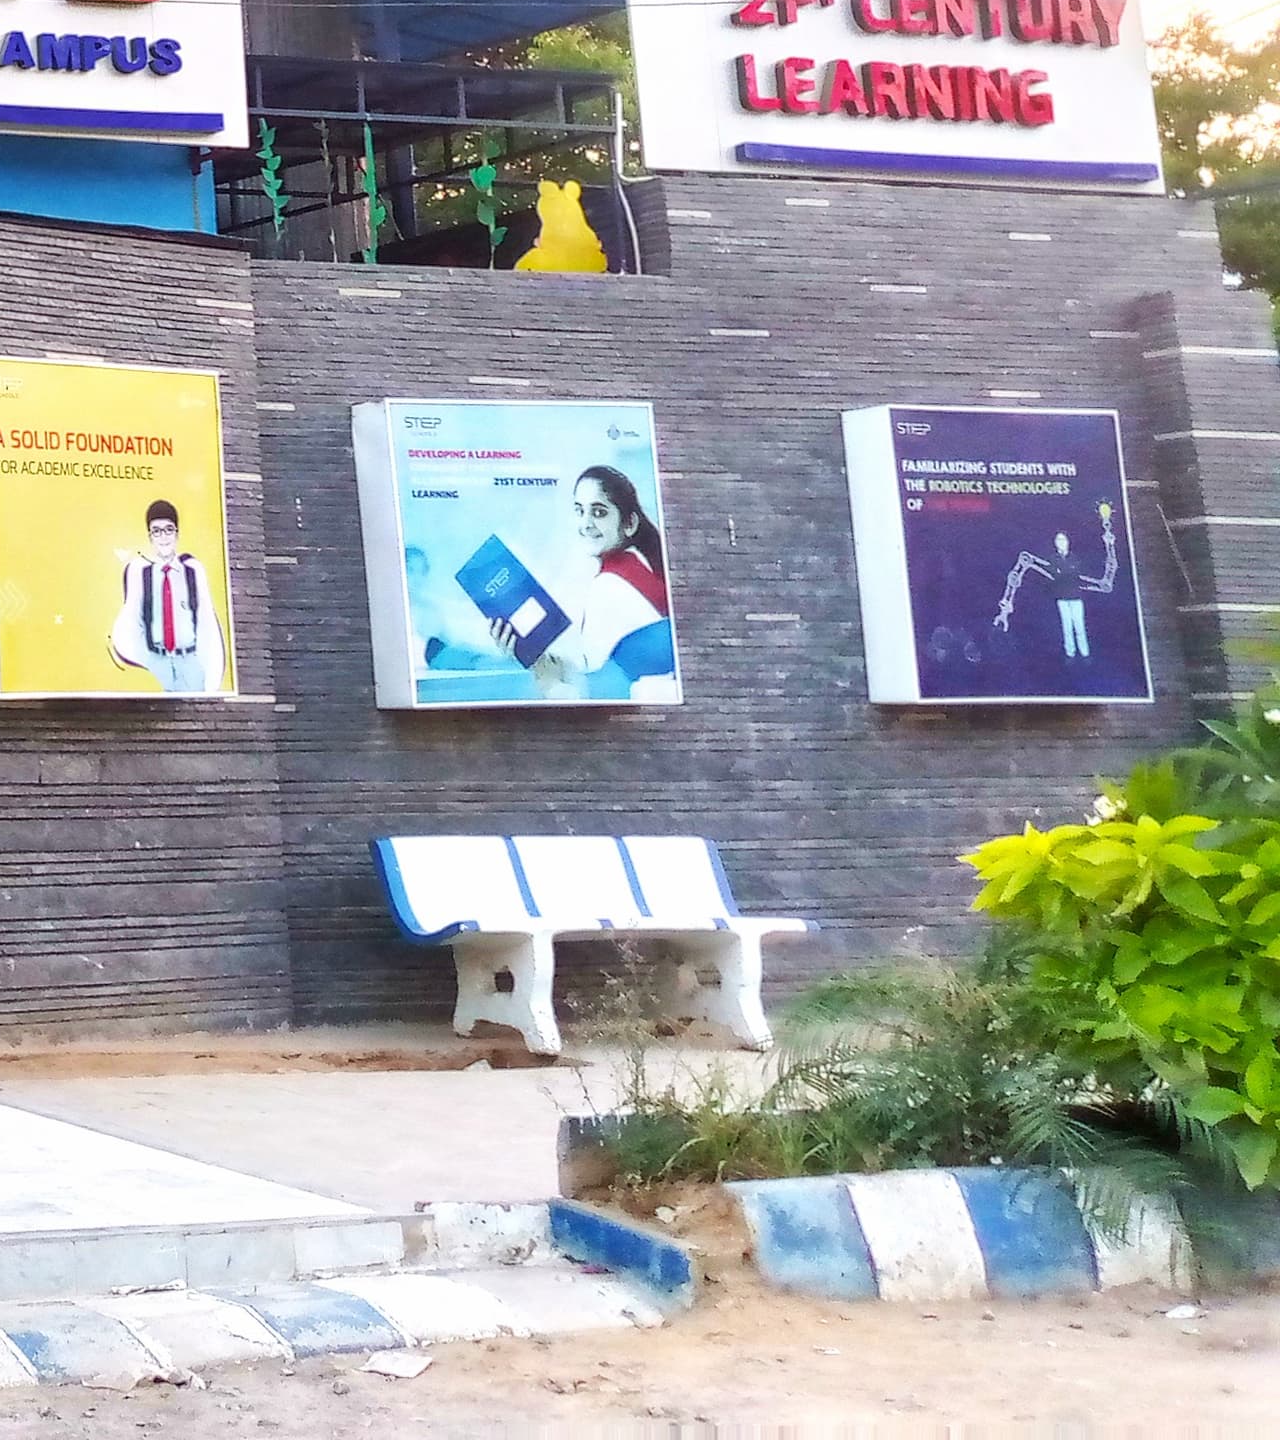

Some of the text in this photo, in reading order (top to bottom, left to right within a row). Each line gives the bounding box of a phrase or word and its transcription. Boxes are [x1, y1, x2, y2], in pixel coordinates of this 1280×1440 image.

[735, 53, 1056, 127] LEARNING
[404, 416, 441, 429] STEP
[896, 422, 932, 436] STEP
[10, 430, 61, 450] SOLID
[65, 432, 174, 457] FOUNDATION
[408, 449, 465, 459] DEVELOPING
[475, 451, 522, 460] LEARNING
[20, 460, 80, 477] ACADEMIC
[83, 463, 154, 481] EXCELLENCE
[902, 460, 1077, 477] FAMILIARIZING STUDENTS WITH
[493, 477, 514, 486] 21ST
[516, 477, 559, 487] CENTURY
[904, 479, 1071, 495] THE ROBOTICS TECHNOLOGIES
[411, 490, 459, 499] LEARNING
[906, 498, 923, 511] OF
